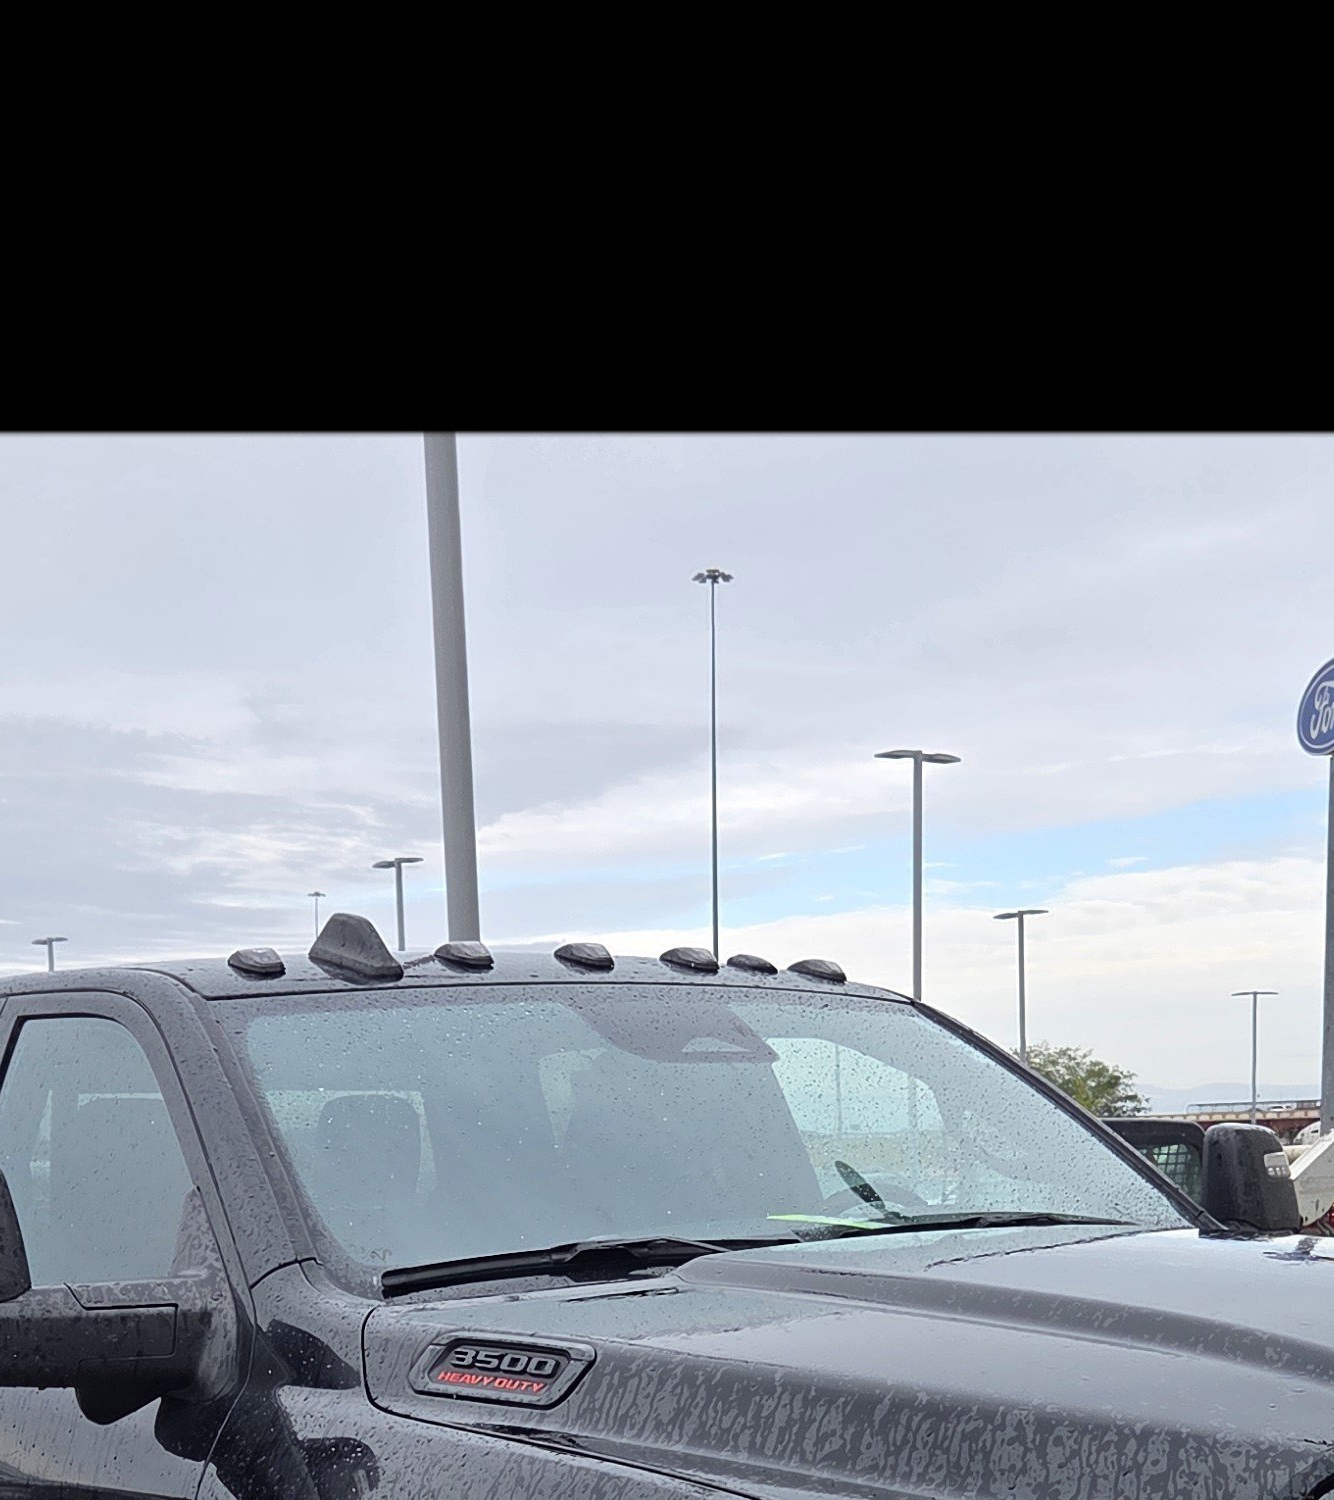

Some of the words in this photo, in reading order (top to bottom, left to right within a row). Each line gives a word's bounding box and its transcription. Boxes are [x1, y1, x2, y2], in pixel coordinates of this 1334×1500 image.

[449, 1348, 557, 1377] 3500
[437, 1371, 494, 1386] HEAVY
[493, 1377, 544, 1392] DUTY
